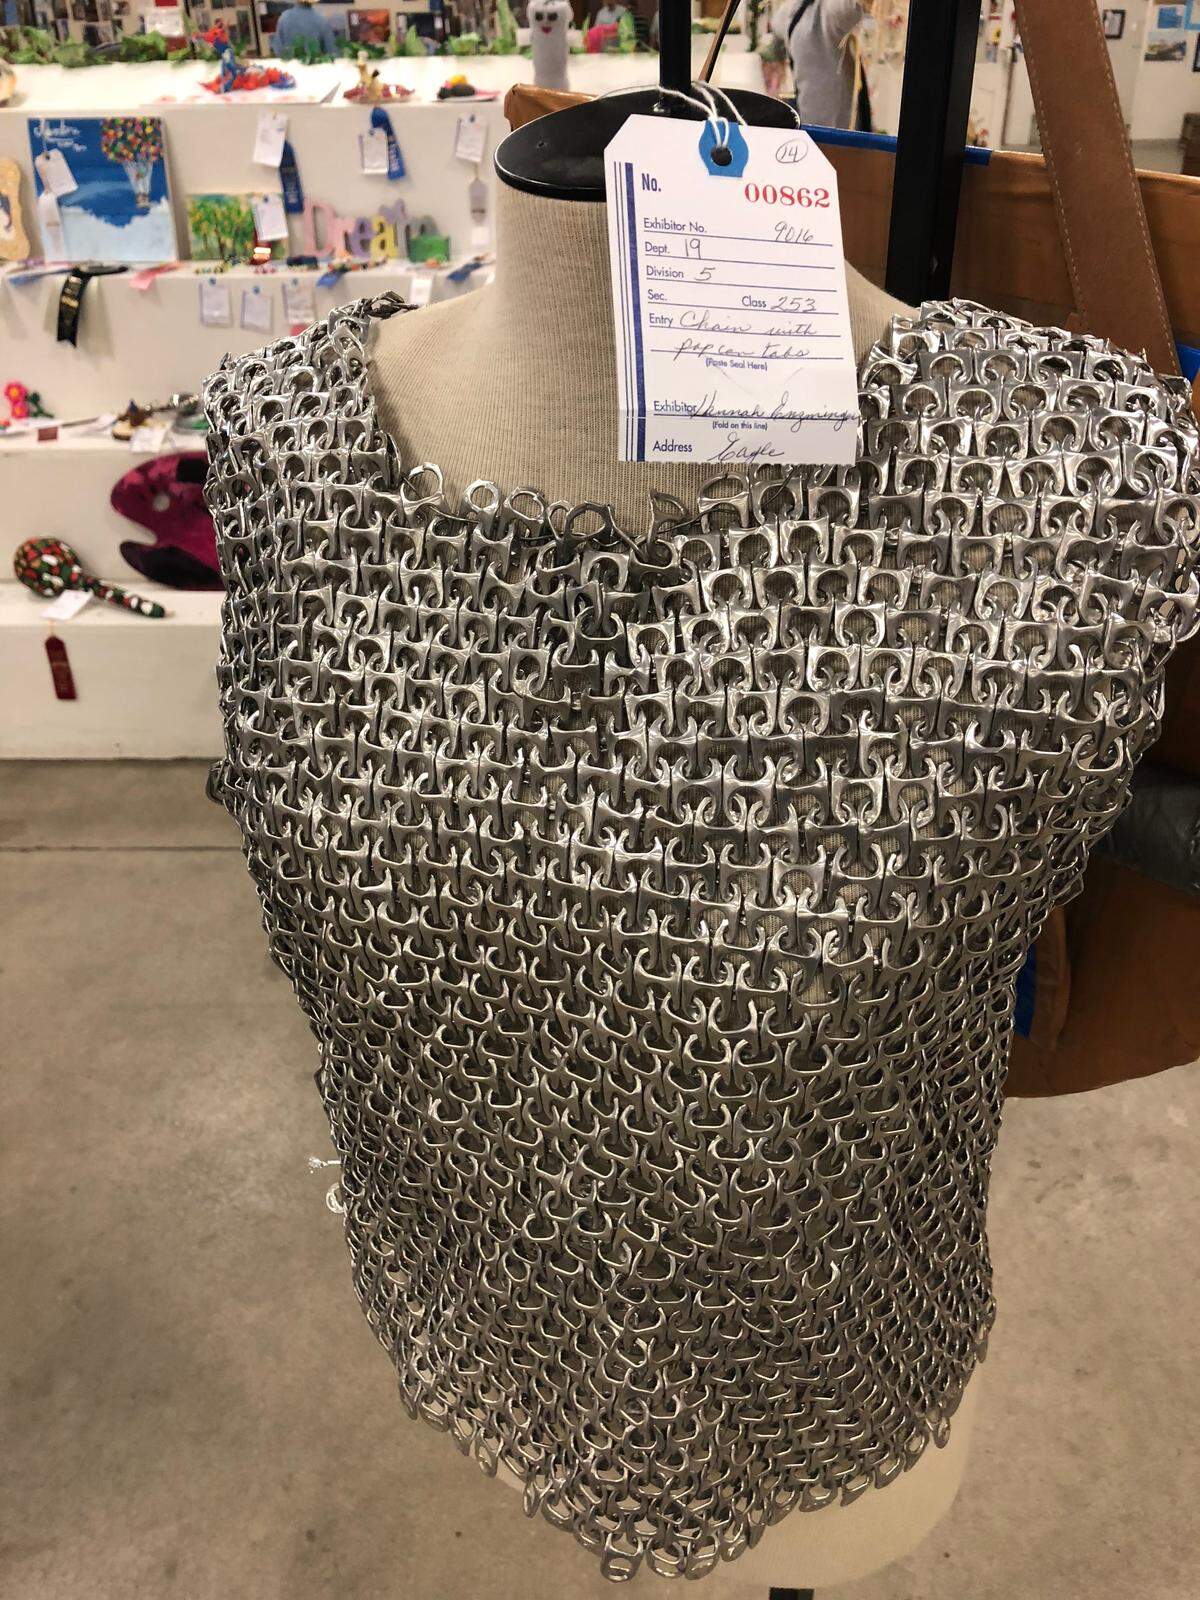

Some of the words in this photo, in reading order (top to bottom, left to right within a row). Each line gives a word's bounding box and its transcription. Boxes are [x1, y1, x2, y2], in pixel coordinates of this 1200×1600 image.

[641, 173, 662, 192] No.
[744, 183, 831, 208] 00862
[643, 217, 686, 232] Exhibitor
[689, 222, 708, 234] No.
[774, 221, 814, 243] 9016
[645, 241, 670, 255] Dept.
[684, 238, 701, 260] 19
[646, 265, 684, 279] Division
[694, 267, 716, 281] 5
[647, 289, 668, 301] Sec.
[741, 296, 767, 308] Class
[770, 296, 817, 313] 253
[649, 313, 674, 327] Entry
[679, 310, 751, 333] Chain
[765, 321, 817, 336] with
[761, 342, 810, 359] tabs
[705, 358, 727, 368] (Paste
[729, 360, 746, 369] Seal
[749, 361, 768, 371] Here)
[653, 400, 697, 413] Exhibitor
[690, 390, 765, 419] Hannah
[712, 420, 729, 431] (Fold
[740, 421, 752, 430] this
[753, 421, 768, 431] line)
[653, 440, 693, 453] Address
[708, 431, 785, 463] Eagle
